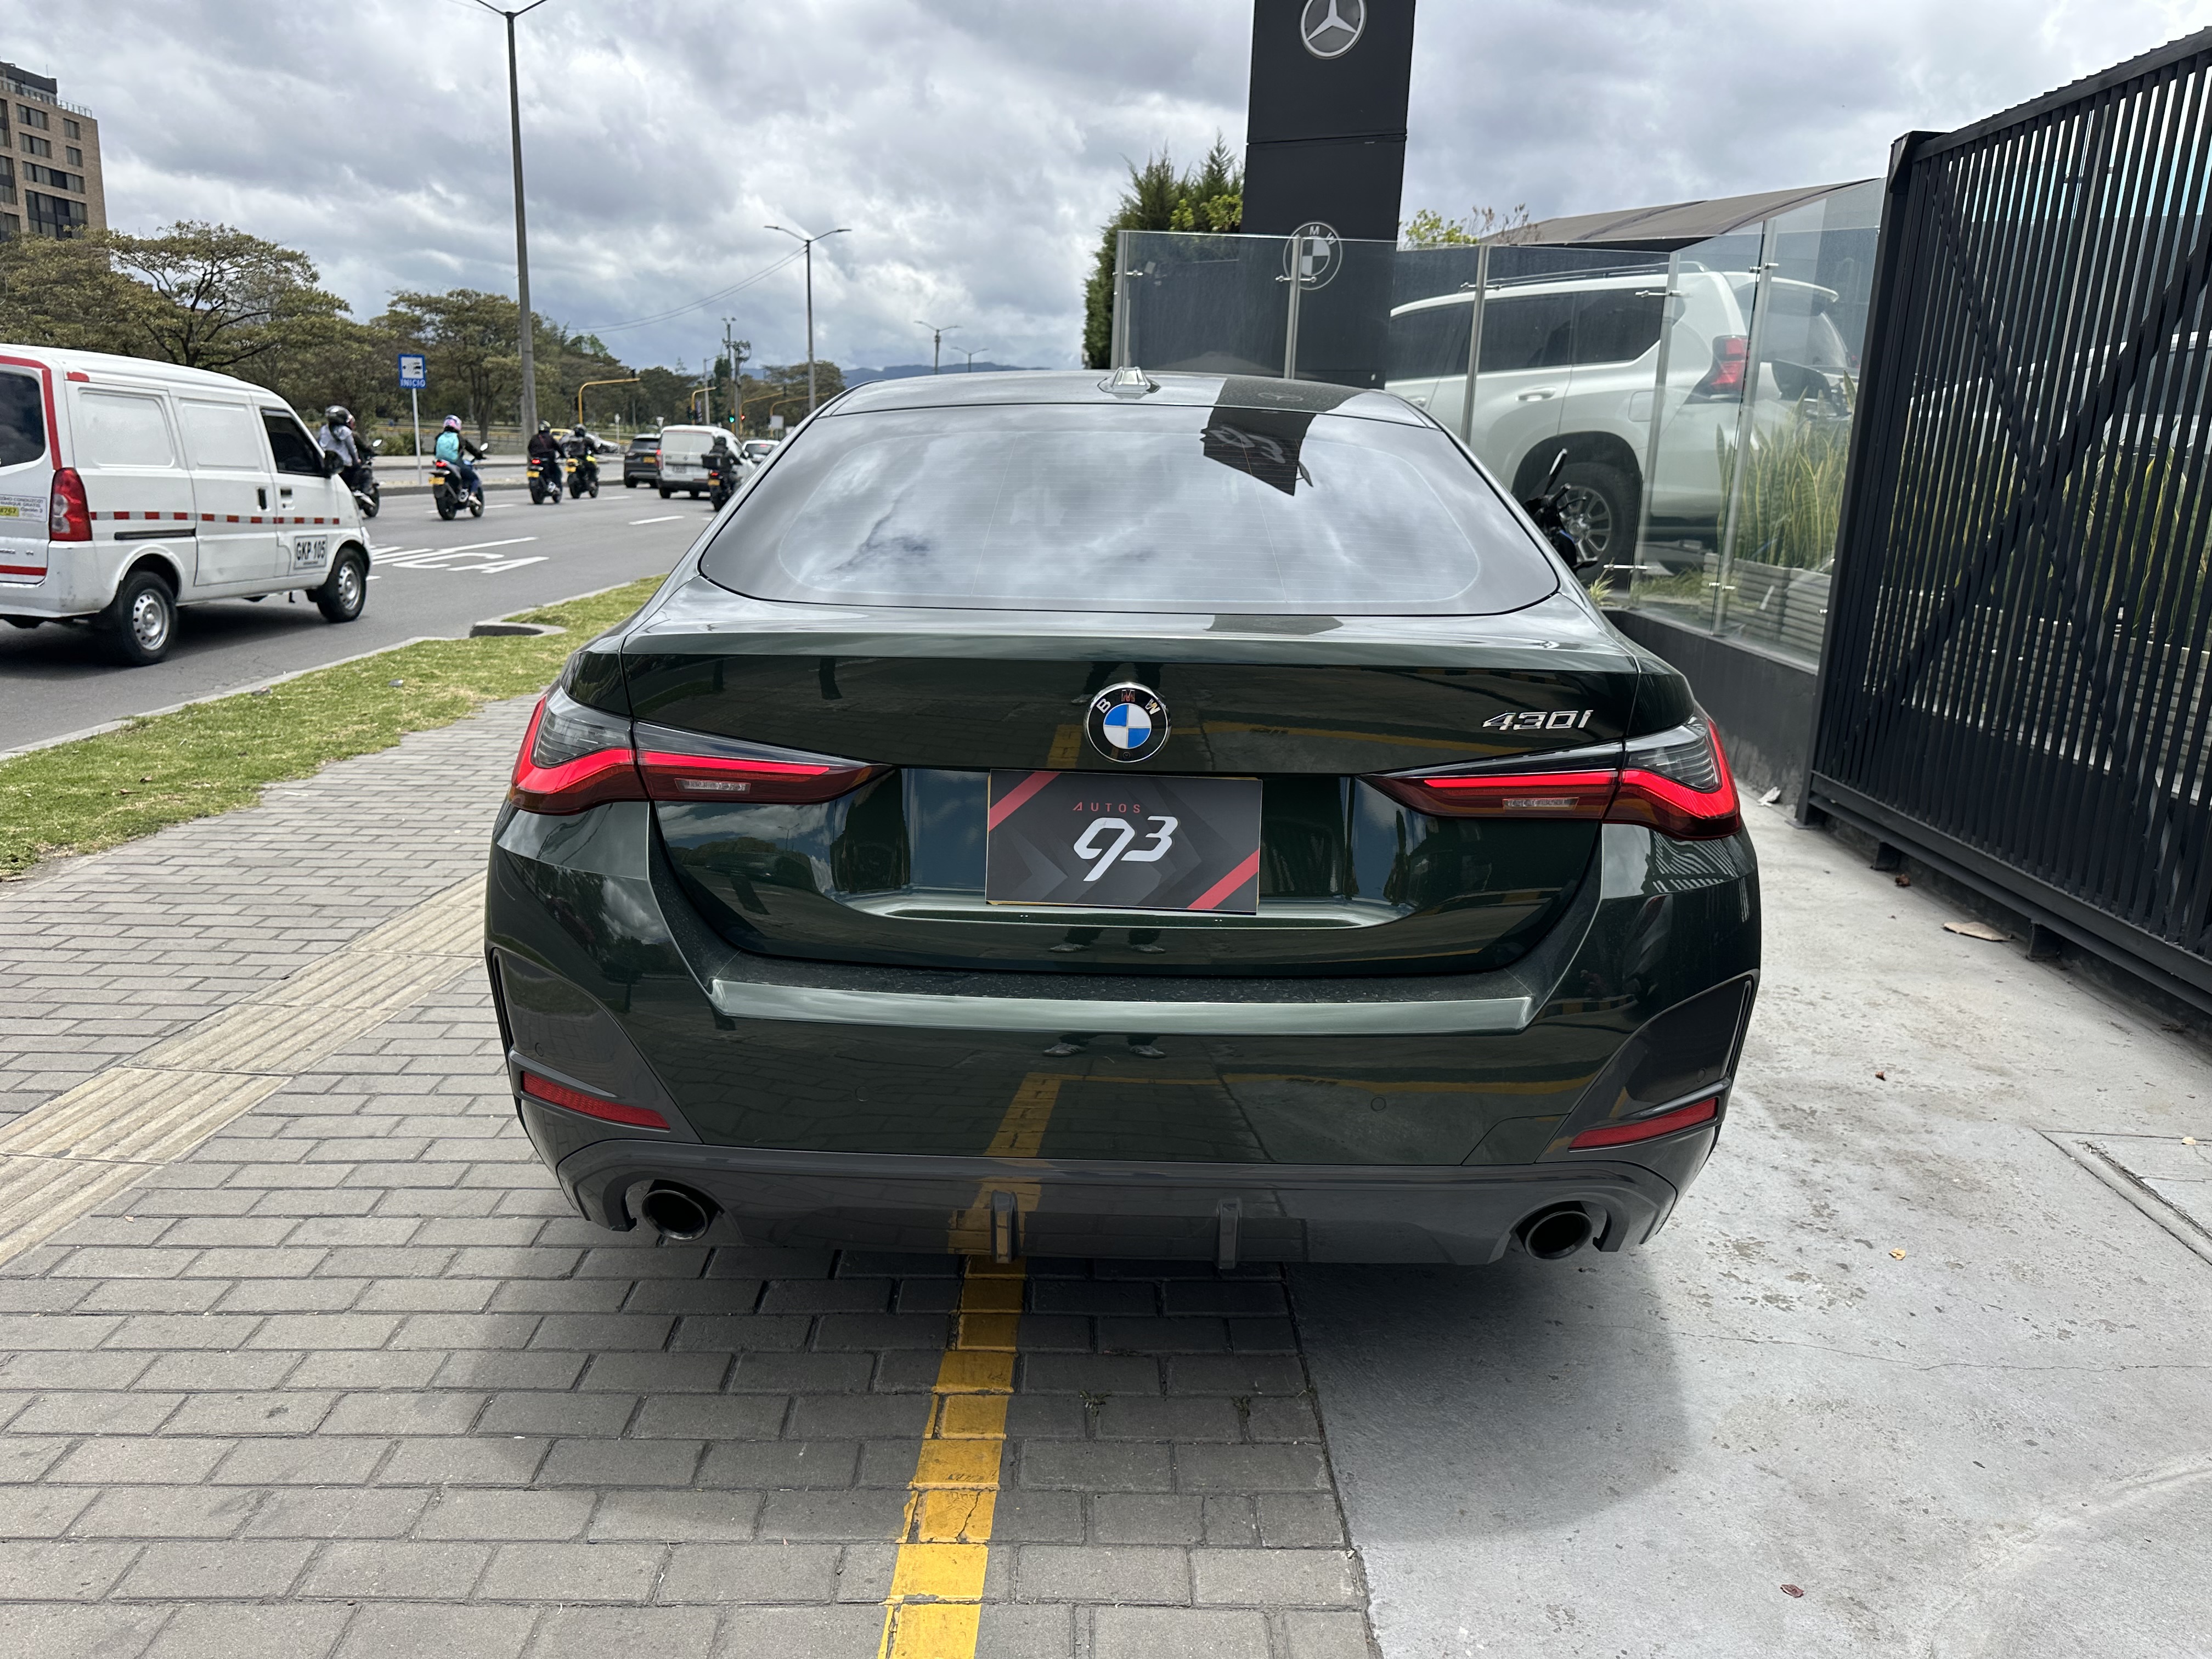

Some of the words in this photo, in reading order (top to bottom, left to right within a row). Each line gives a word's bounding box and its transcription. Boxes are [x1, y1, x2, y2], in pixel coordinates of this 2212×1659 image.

[400, 379, 426, 387] INICIO
[1096, 689, 1161, 715] BMW
[1482, 709, 1594, 731] 430i
[1072, 801, 1141, 814] AUTOS
[1073, 815, 1178, 882] 93
